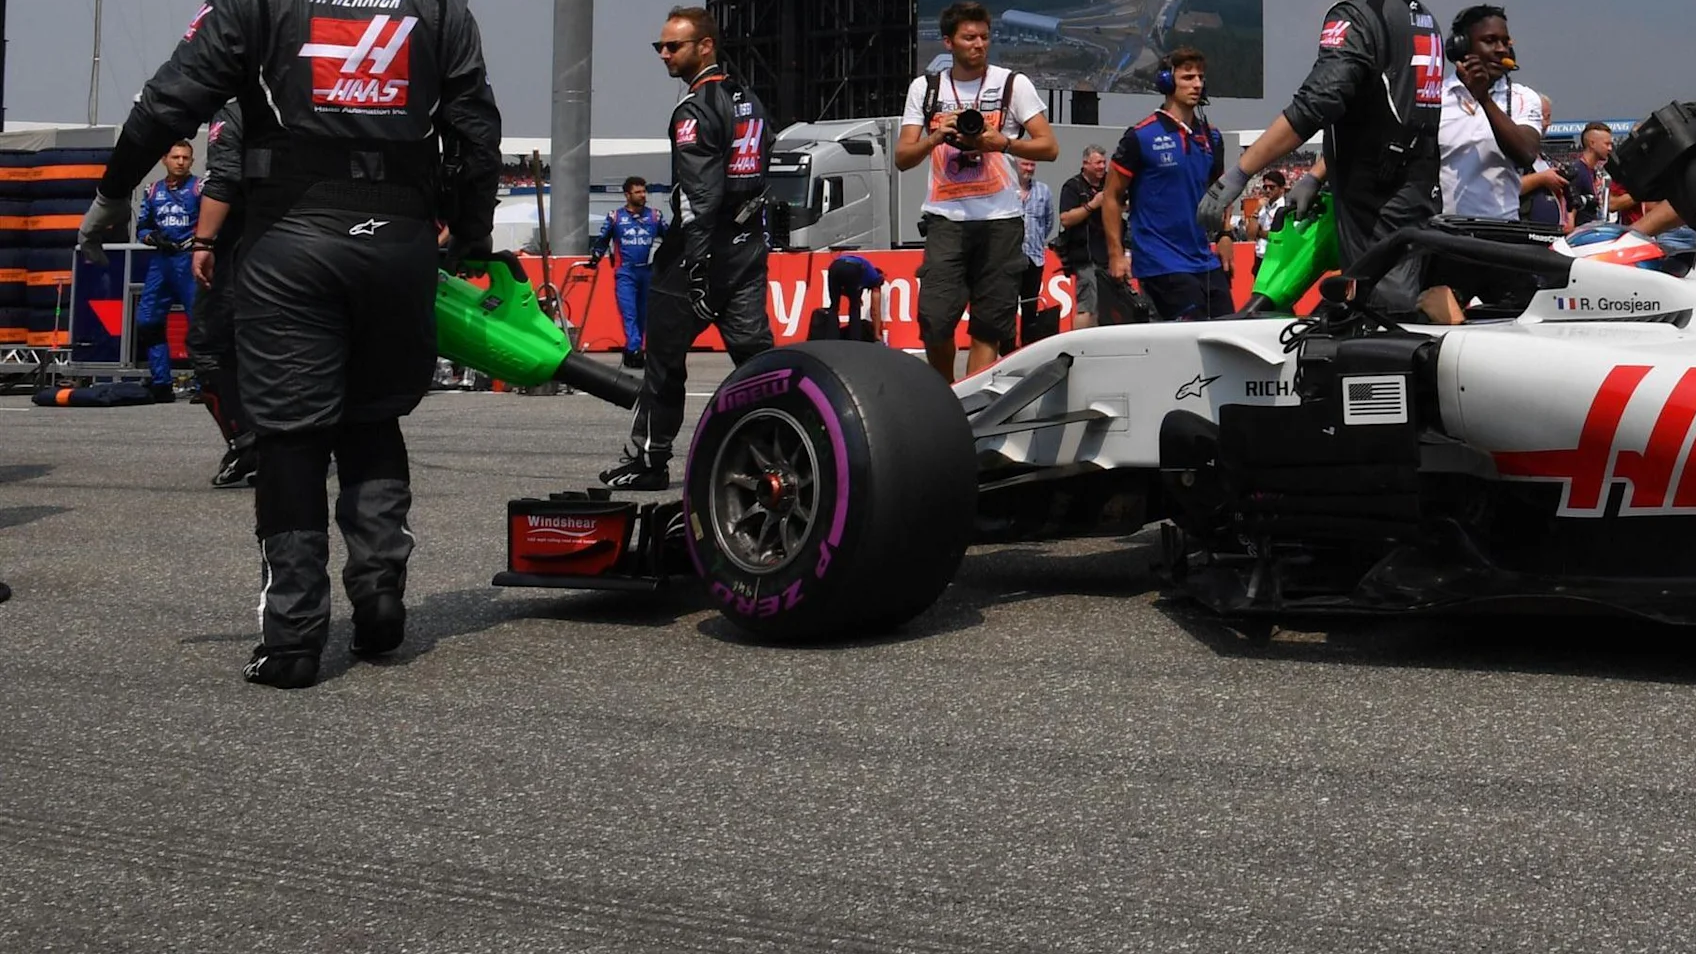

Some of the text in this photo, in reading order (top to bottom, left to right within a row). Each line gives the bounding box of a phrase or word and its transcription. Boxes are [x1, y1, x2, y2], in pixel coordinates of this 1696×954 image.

[312, 78, 409, 102] HAAS
[1580, 297, 1661, 313] R. Grosjean
[717, 368, 793, 413] PIRELLI
[527, 514, 598, 529] Windshear
[711, 579, 805, 617] ZERO
